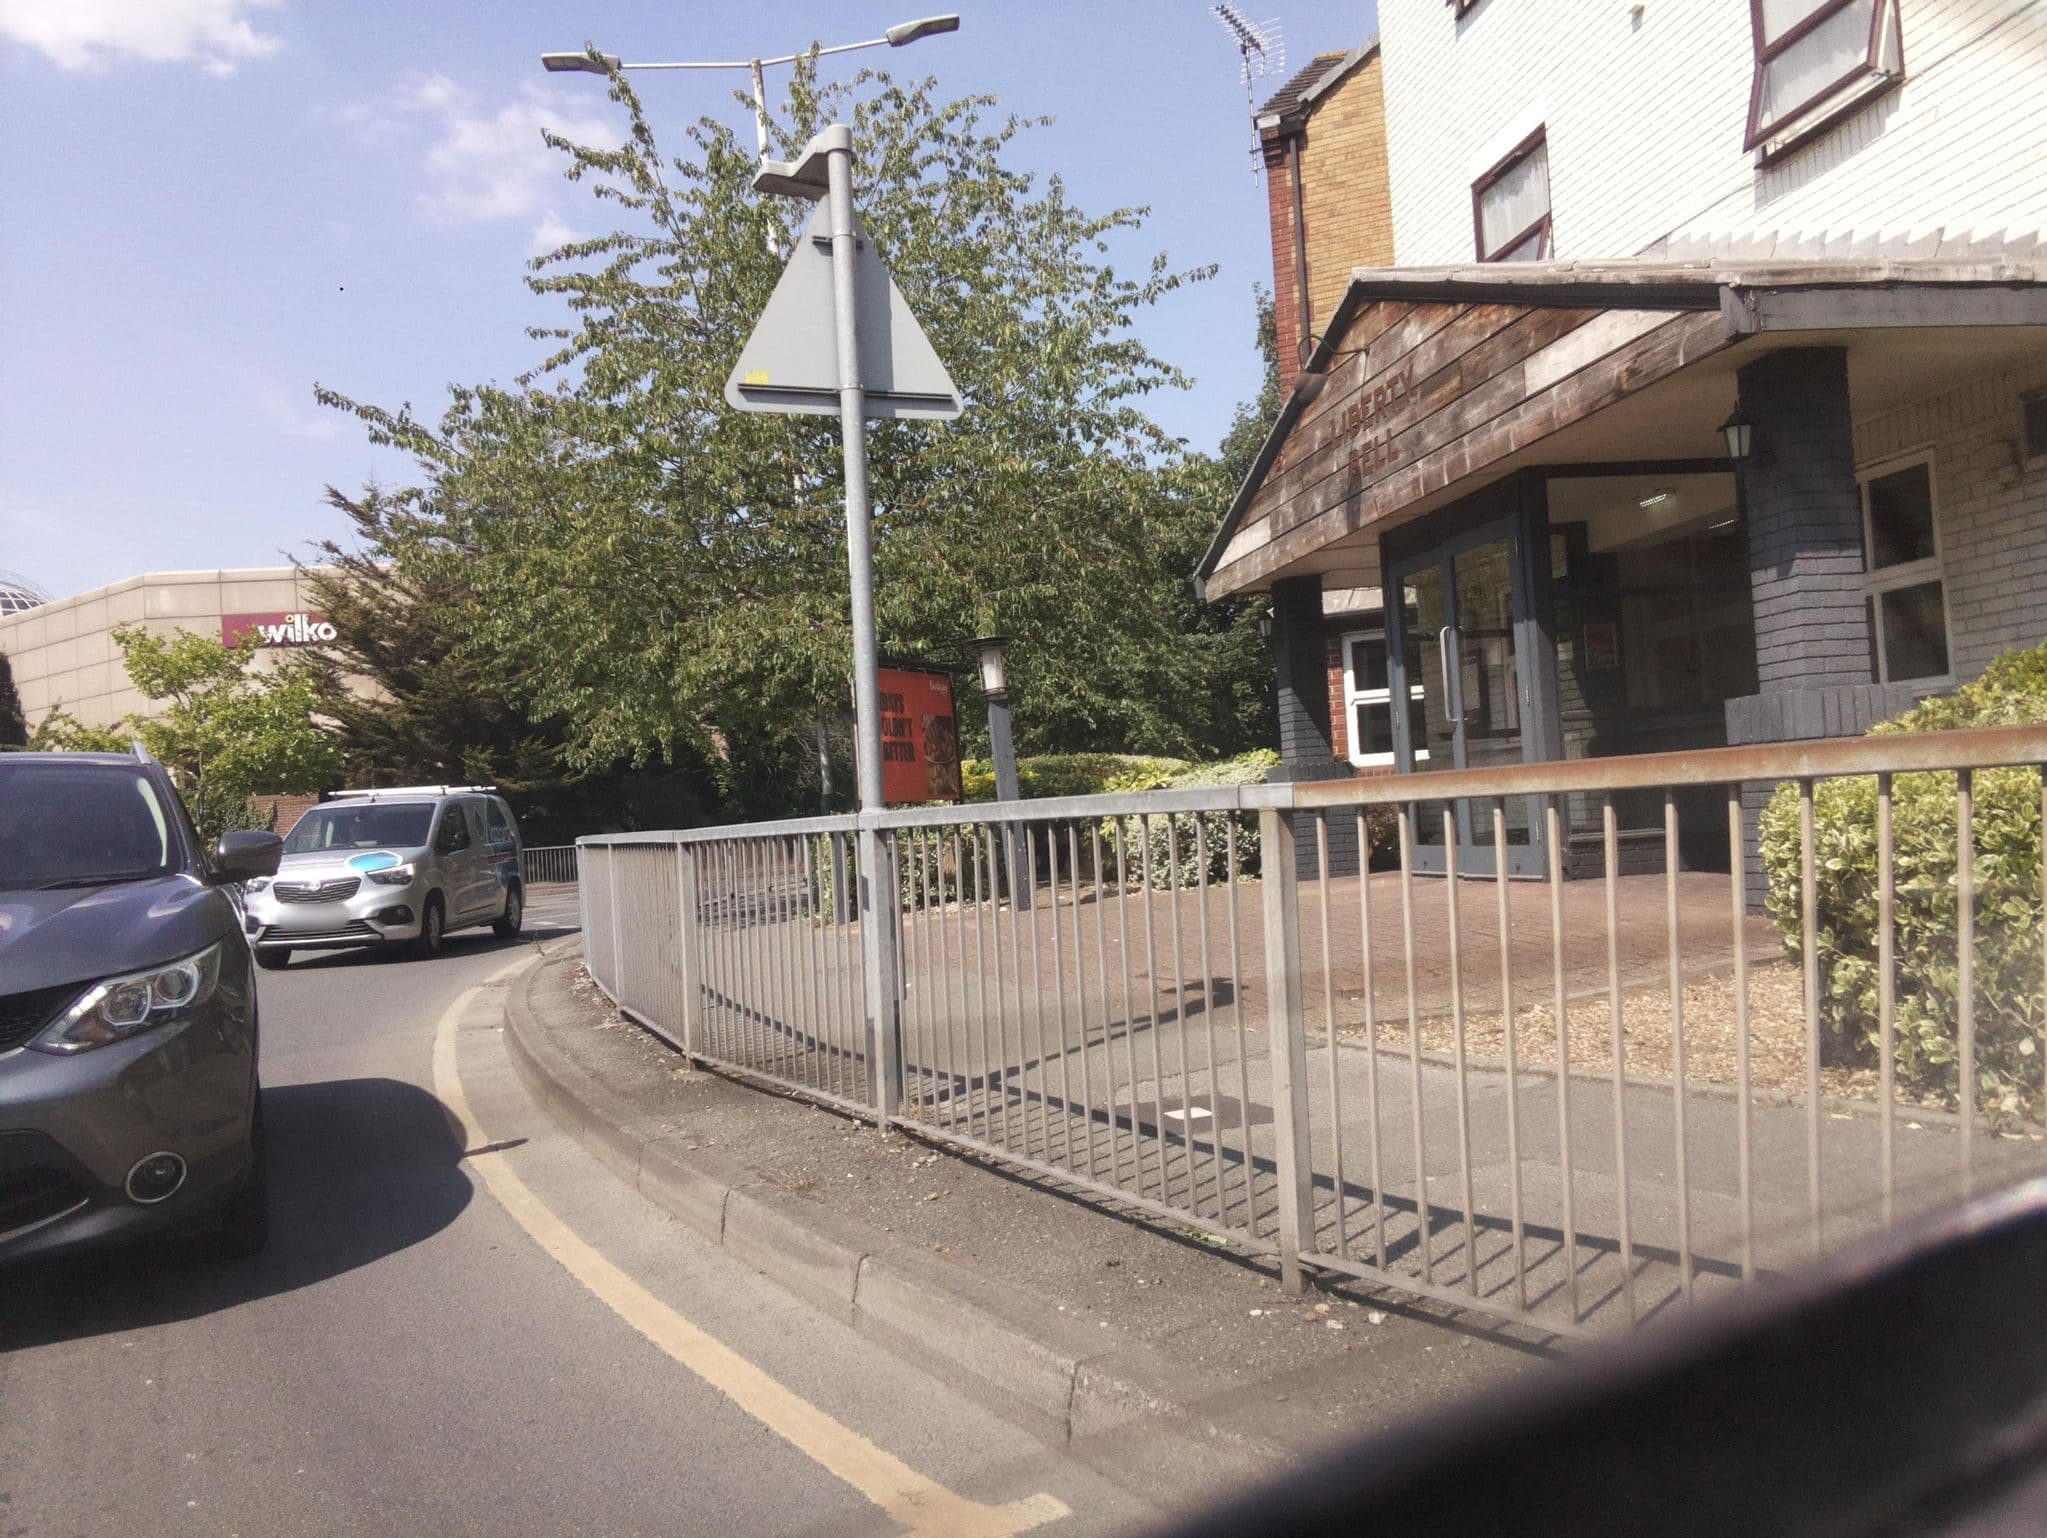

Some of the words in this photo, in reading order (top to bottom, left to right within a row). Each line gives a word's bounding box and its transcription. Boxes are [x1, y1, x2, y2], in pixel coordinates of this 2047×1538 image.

[1331, 363, 1414, 450] LIBERTY
[1349, 428, 1399, 479] BELL
[258, 613, 337, 643] wilko
